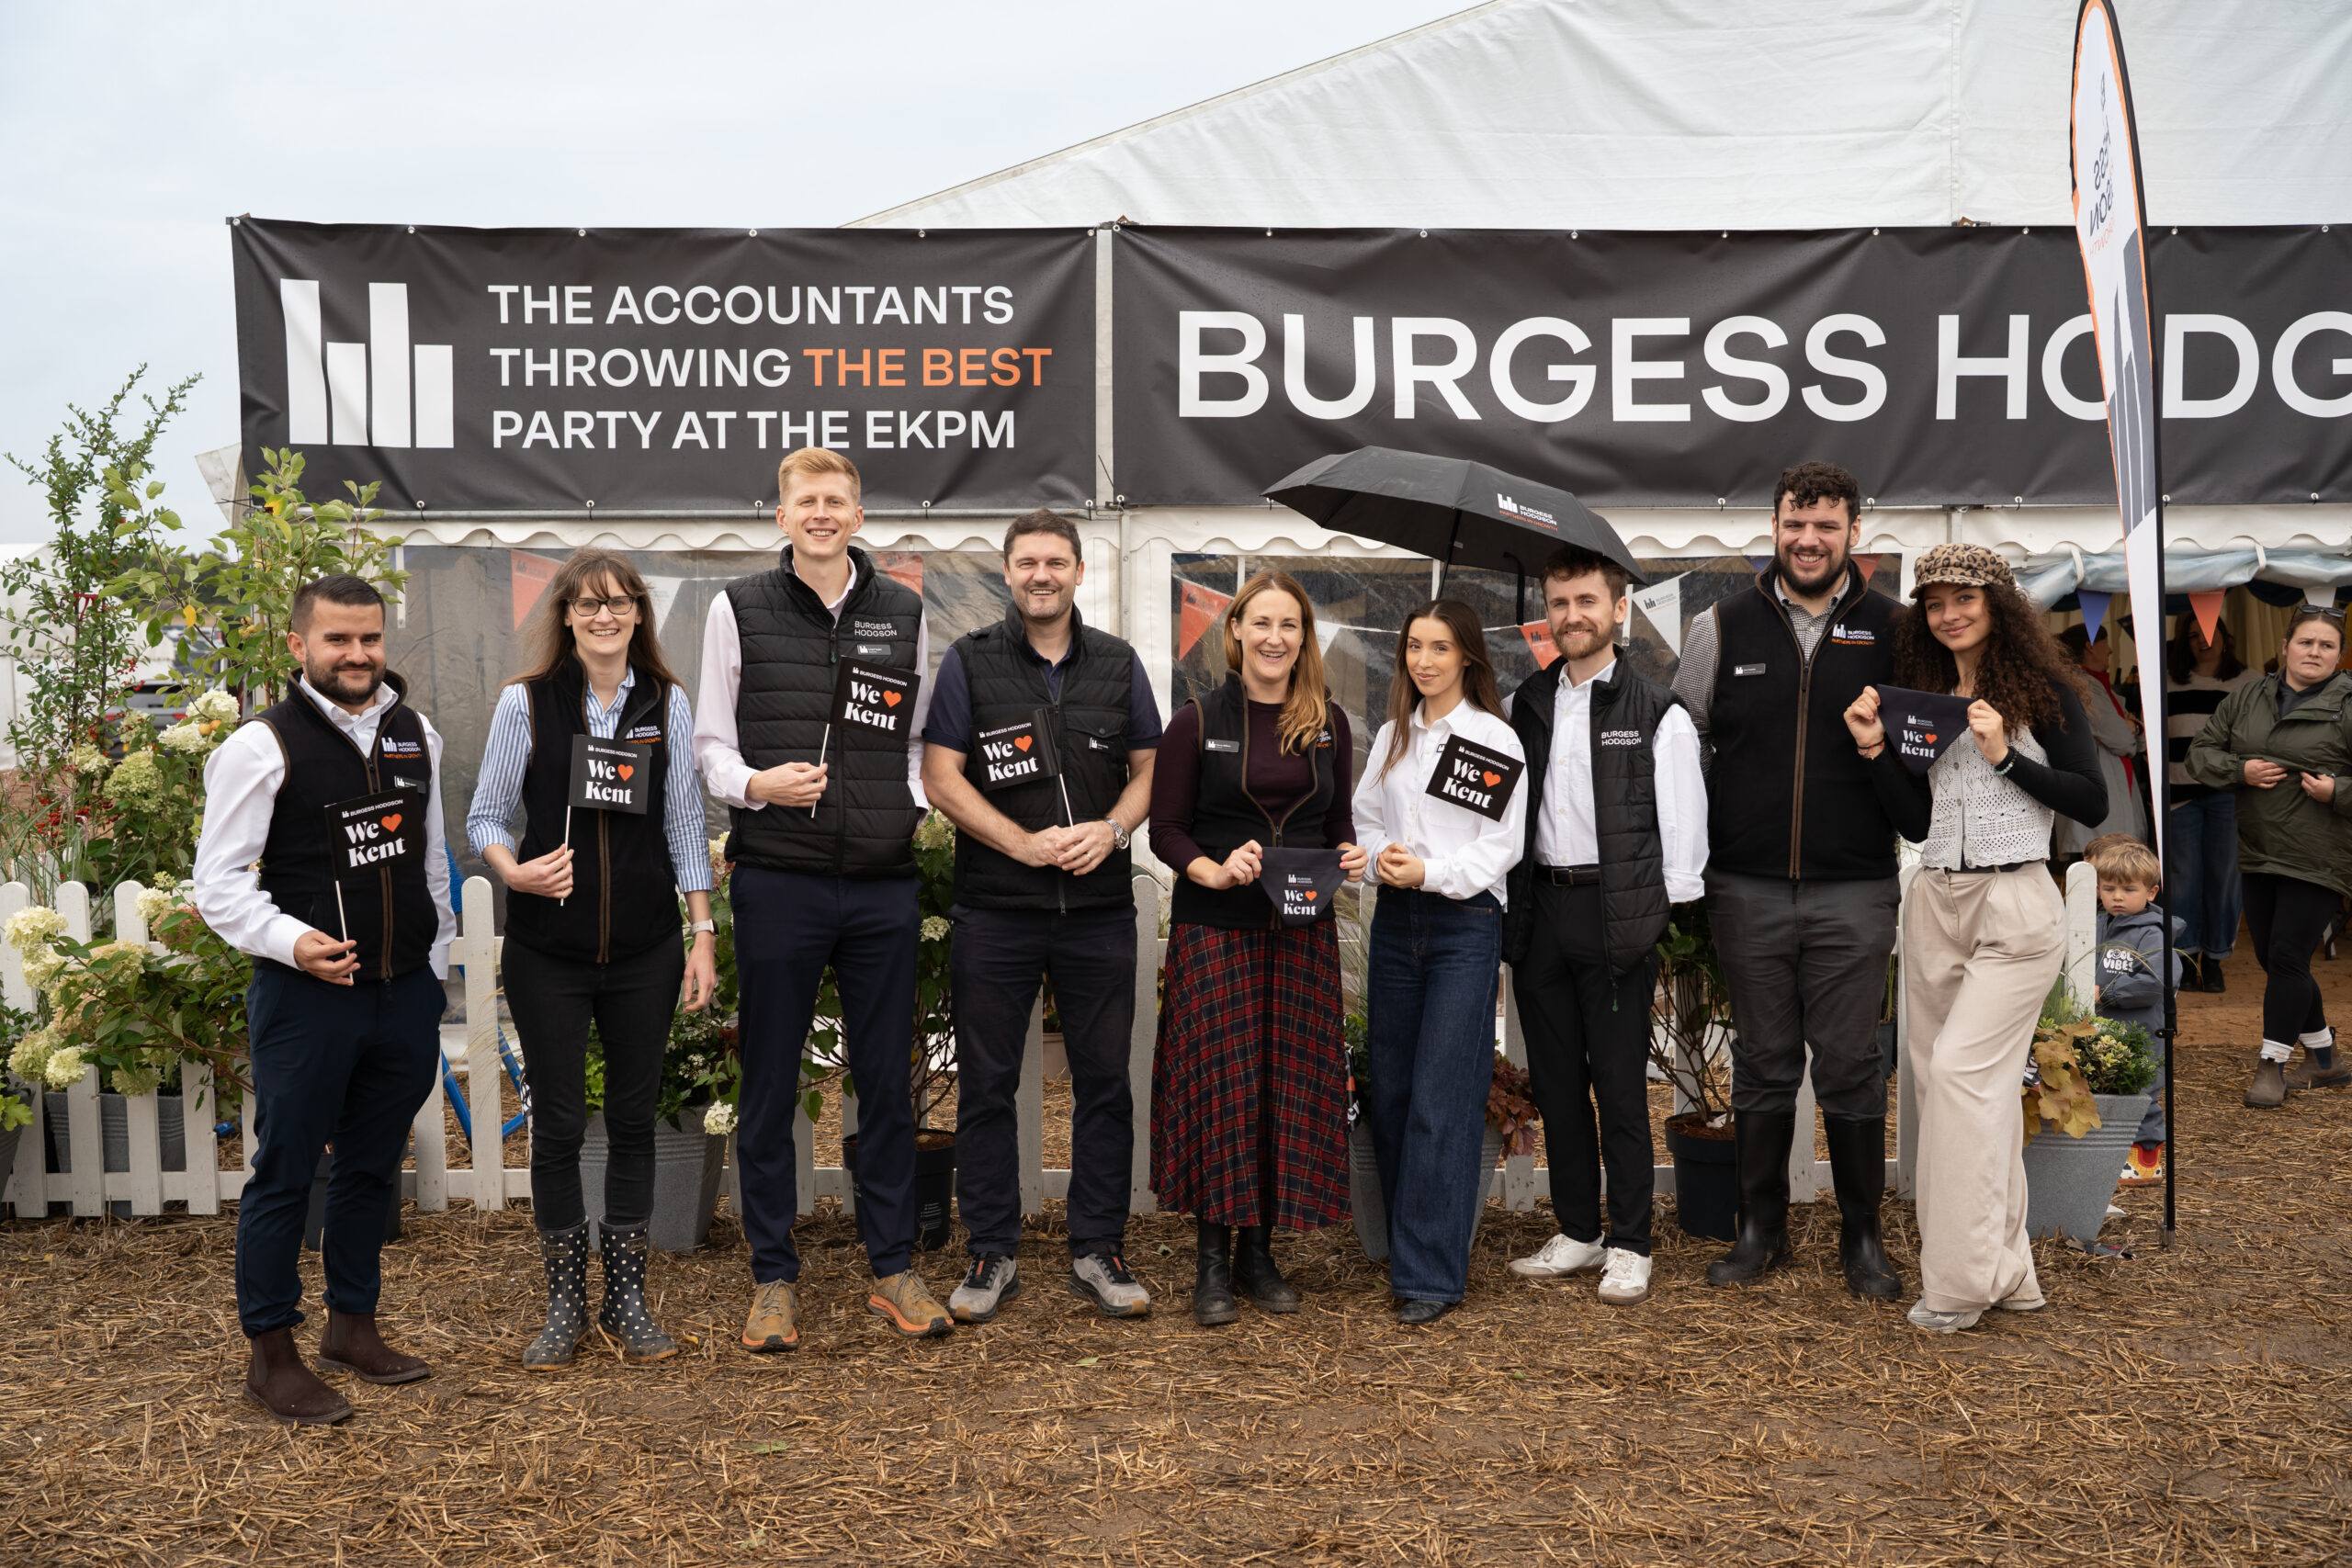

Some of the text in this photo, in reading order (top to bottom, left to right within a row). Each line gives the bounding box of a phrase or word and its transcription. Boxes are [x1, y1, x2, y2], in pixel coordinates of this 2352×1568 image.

[488, 285, 1014, 325] THE ACCOUNTANTS
[490, 346, 1053, 388] THROWING THE BEST
[1179, 310, 1888, 423] BURGESS
[492, 411, 1015, 449] PARTY AT THE EKPM
[1519, 504, 1553, 520] BURGESS
[1521, 511, 1557, 525] HODGSON
[854, 620, 892, 630] BURGESS
[854, 629, 898, 637] HODGSON
[859, 671, 908, 687] BURGESS HODGSON
[850, 680, 881, 705] We
[843, 701, 898, 731] Kent
[985, 722, 1032, 738] BURGESS HODGSON
[1600, 730, 1640, 739] BURGESS
[1903, 729, 1924, 743] We
[982, 741, 1014, 761] We
[1601, 737, 1642, 747] HODGSON
[1901, 742, 1935, 759] Kent
[594, 747, 638, 759] BURGESS HODGSON
[1464, 750, 1510, 771] BURGESS HODGSON
[587, 759, 616, 781] We
[987, 756, 1039, 782] Kent
[1453, 758, 1481, 783] We
[584, 780, 633, 805] Kent
[1442, 776, 1494, 809] Kent
[350, 799, 404, 817] BURGESS HODGSON
[344, 820, 379, 844] We
[347, 837, 406, 868] Kent
[1283, 889, 1304, 902] We
[1283, 903, 1317, 916] Kent
[2103, 957, 2134, 972] VIBES
